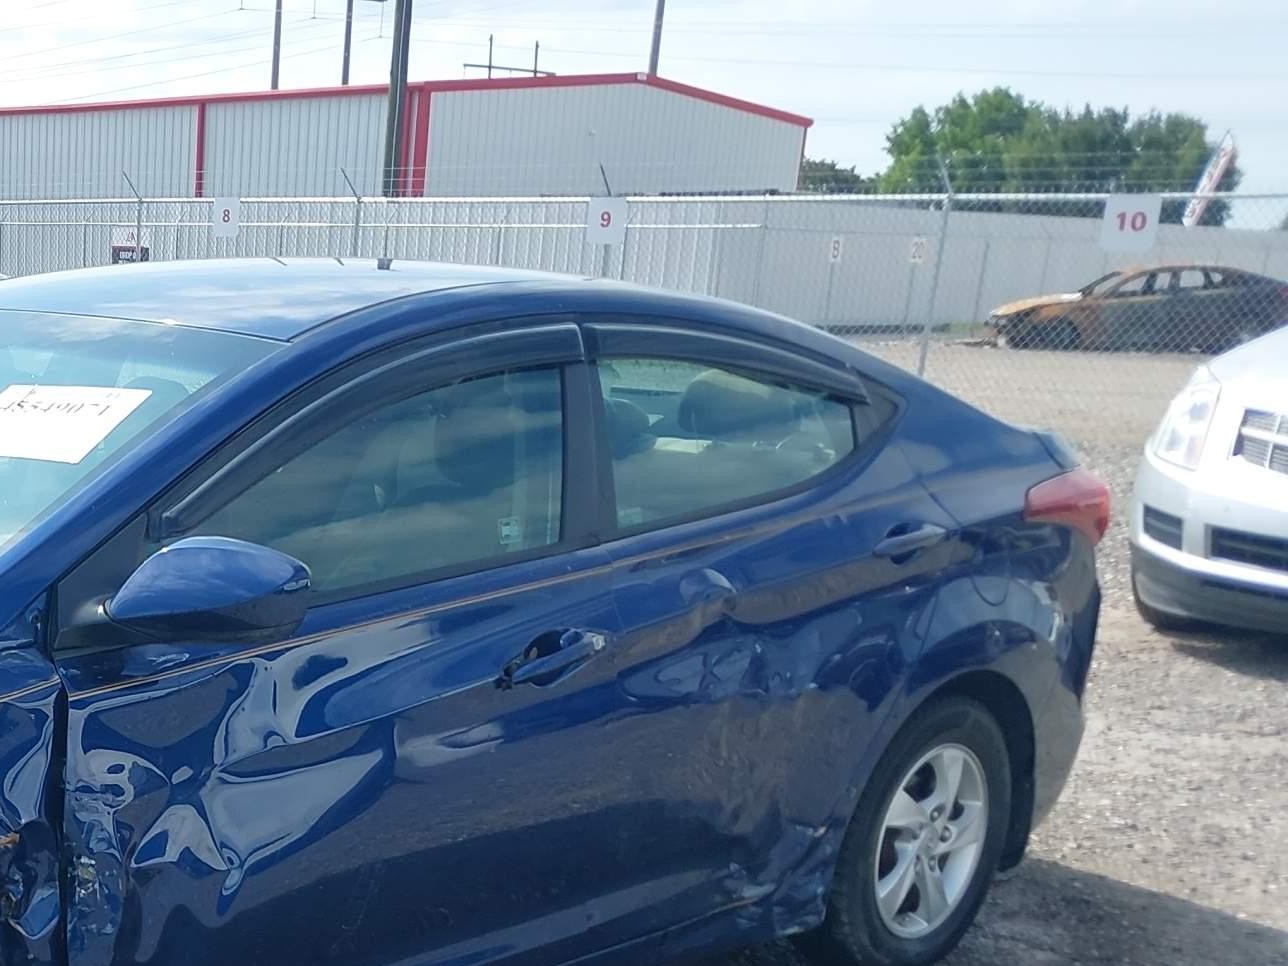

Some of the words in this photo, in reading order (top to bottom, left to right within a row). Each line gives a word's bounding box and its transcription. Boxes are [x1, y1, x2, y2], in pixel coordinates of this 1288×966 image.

[222, 208, 231, 223] 8
[600, 211, 611, 228] 9
[1116, 211, 1148, 233] 10
